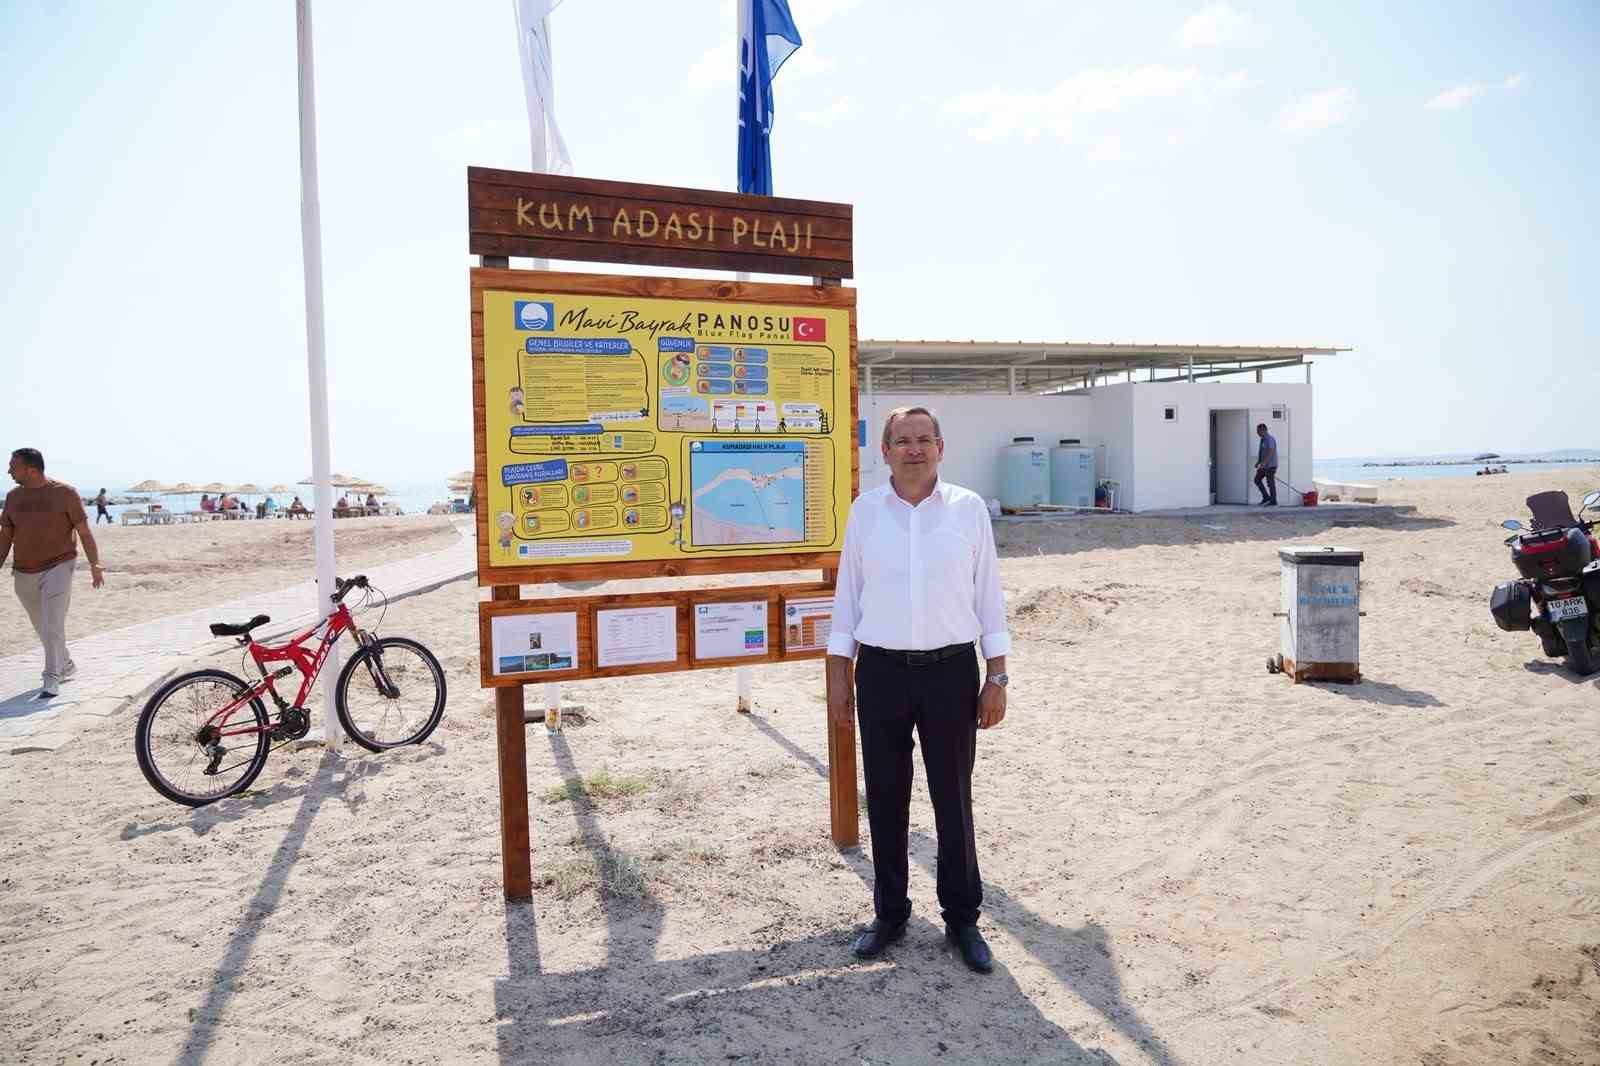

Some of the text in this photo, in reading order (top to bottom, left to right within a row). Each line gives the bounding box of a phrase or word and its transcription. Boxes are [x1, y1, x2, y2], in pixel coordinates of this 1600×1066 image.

[516, 197, 812, 253] KUM ADASI PLAJI
[560, 307, 790, 341] Mavi Bayrak PANOSU
[697, 329, 722, 337] Blue
[729, 330, 753, 339] Flag
